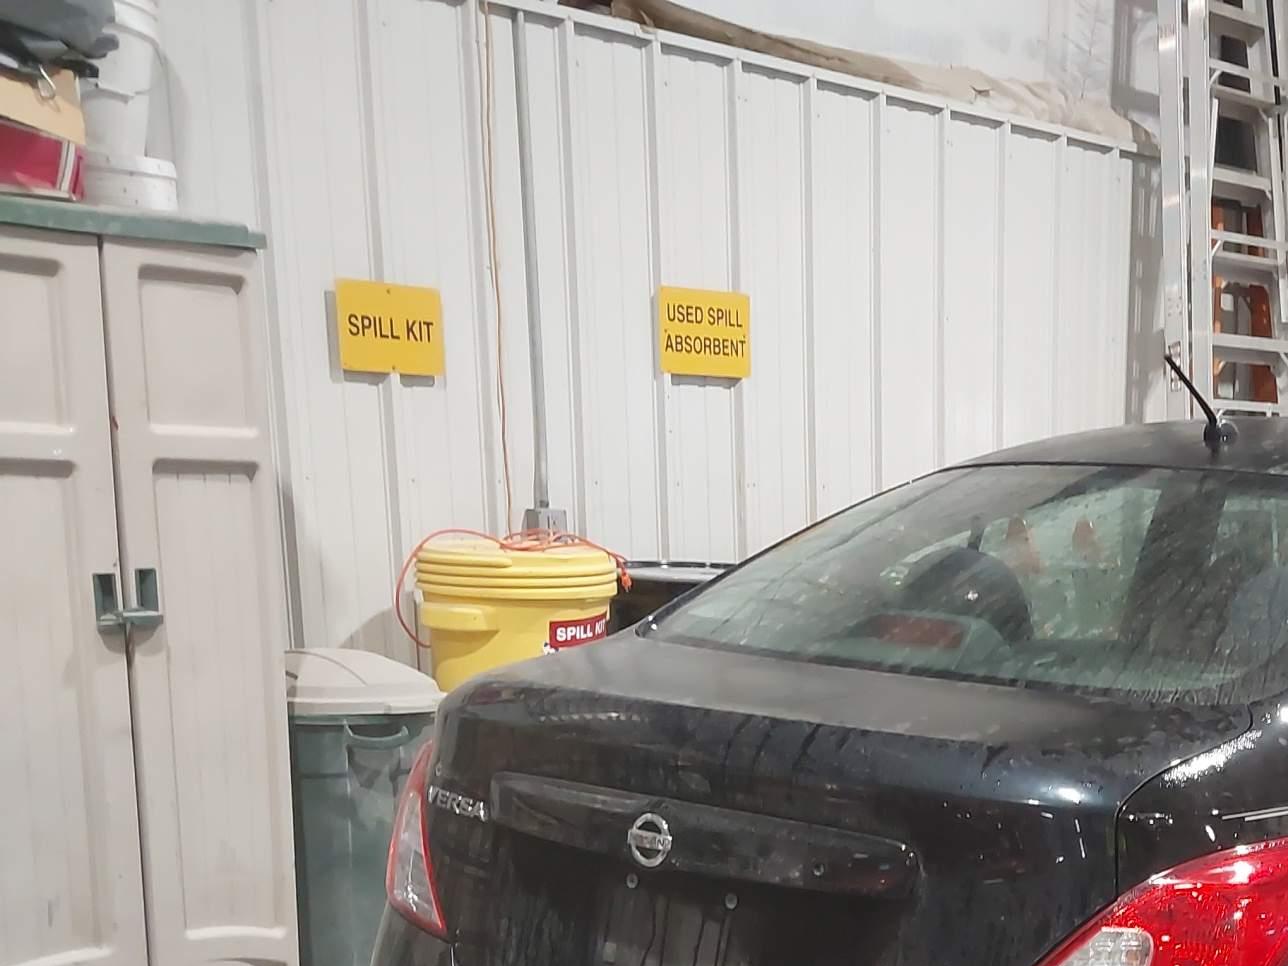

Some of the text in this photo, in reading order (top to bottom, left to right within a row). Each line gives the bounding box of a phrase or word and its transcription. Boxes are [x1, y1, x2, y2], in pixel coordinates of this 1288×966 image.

[347, 313, 434, 343] SPILL KIT
[666, 303, 743, 328] USED SPILL
[664, 333, 746, 358] ABSORBENT
[556, 623, 593, 642] SPILL
[428, 785, 486, 822] VERSA
